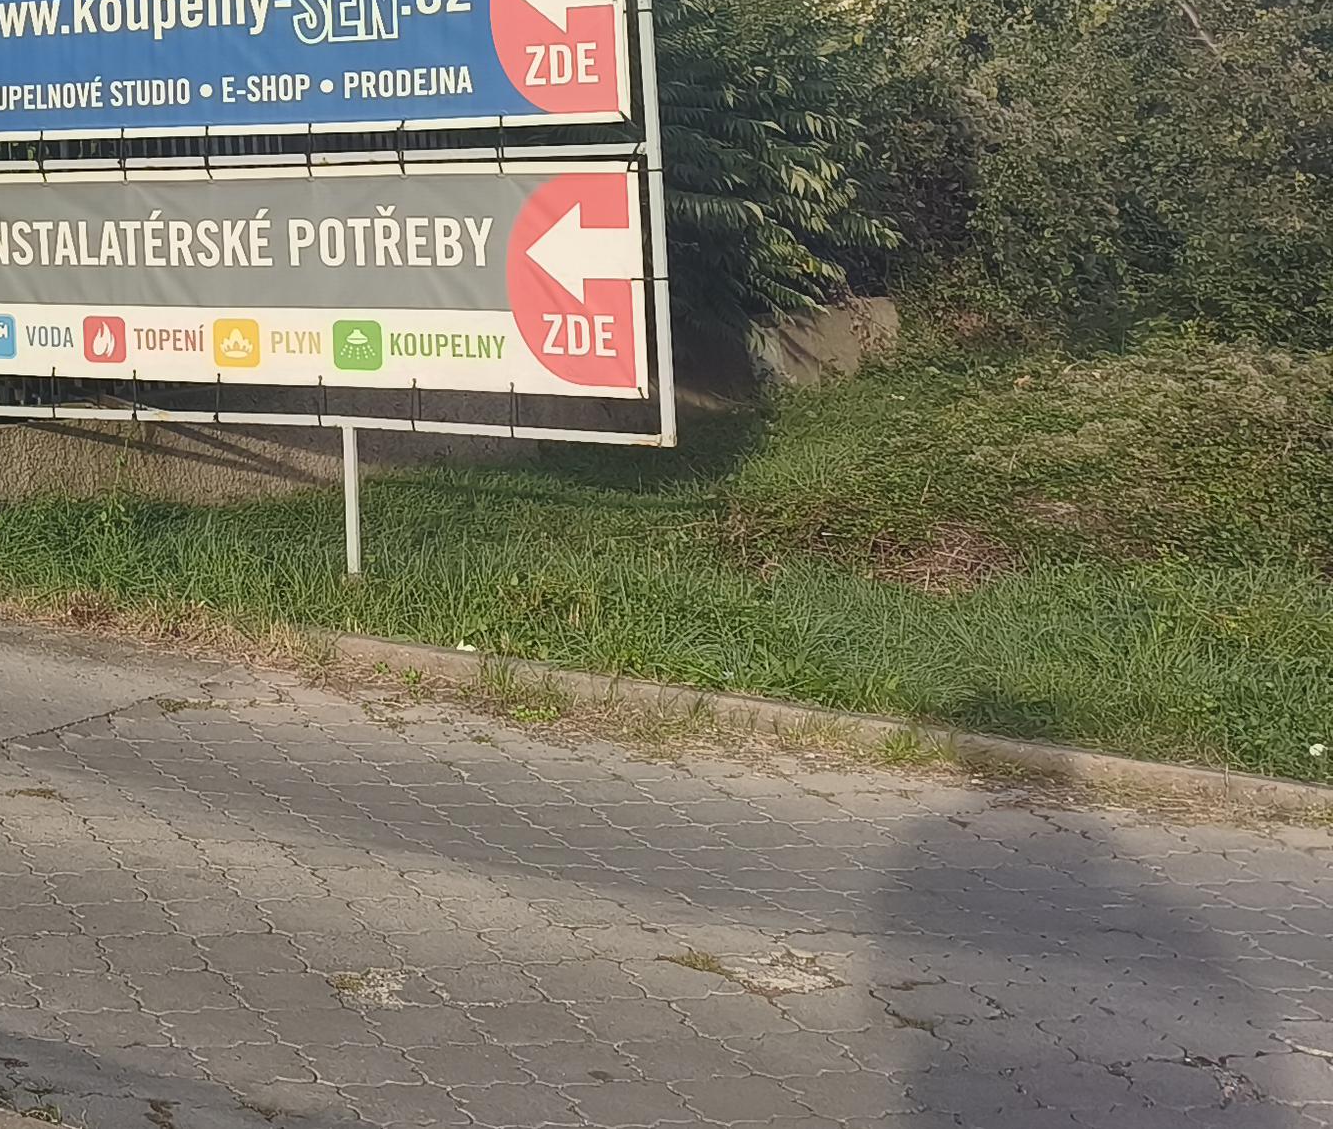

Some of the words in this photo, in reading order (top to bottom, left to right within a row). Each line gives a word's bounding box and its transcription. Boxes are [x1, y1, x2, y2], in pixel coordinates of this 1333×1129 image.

[524, 41, 600, 86] ZDE
[110, 77, 191, 106] STUDIO
[222, 72, 310, 104] E-SHOP
[343, 65, 473, 99] PRODEJNA
[288, 204, 494, 268] POTŘEBY
[26, 324, 74, 349] VODA
[134, 323, 204, 353] TOPENÍ
[270, 329, 322, 355] PLYN
[390, 331, 506, 360] KOUPELNY
[541, 313, 618, 357] ZDE
